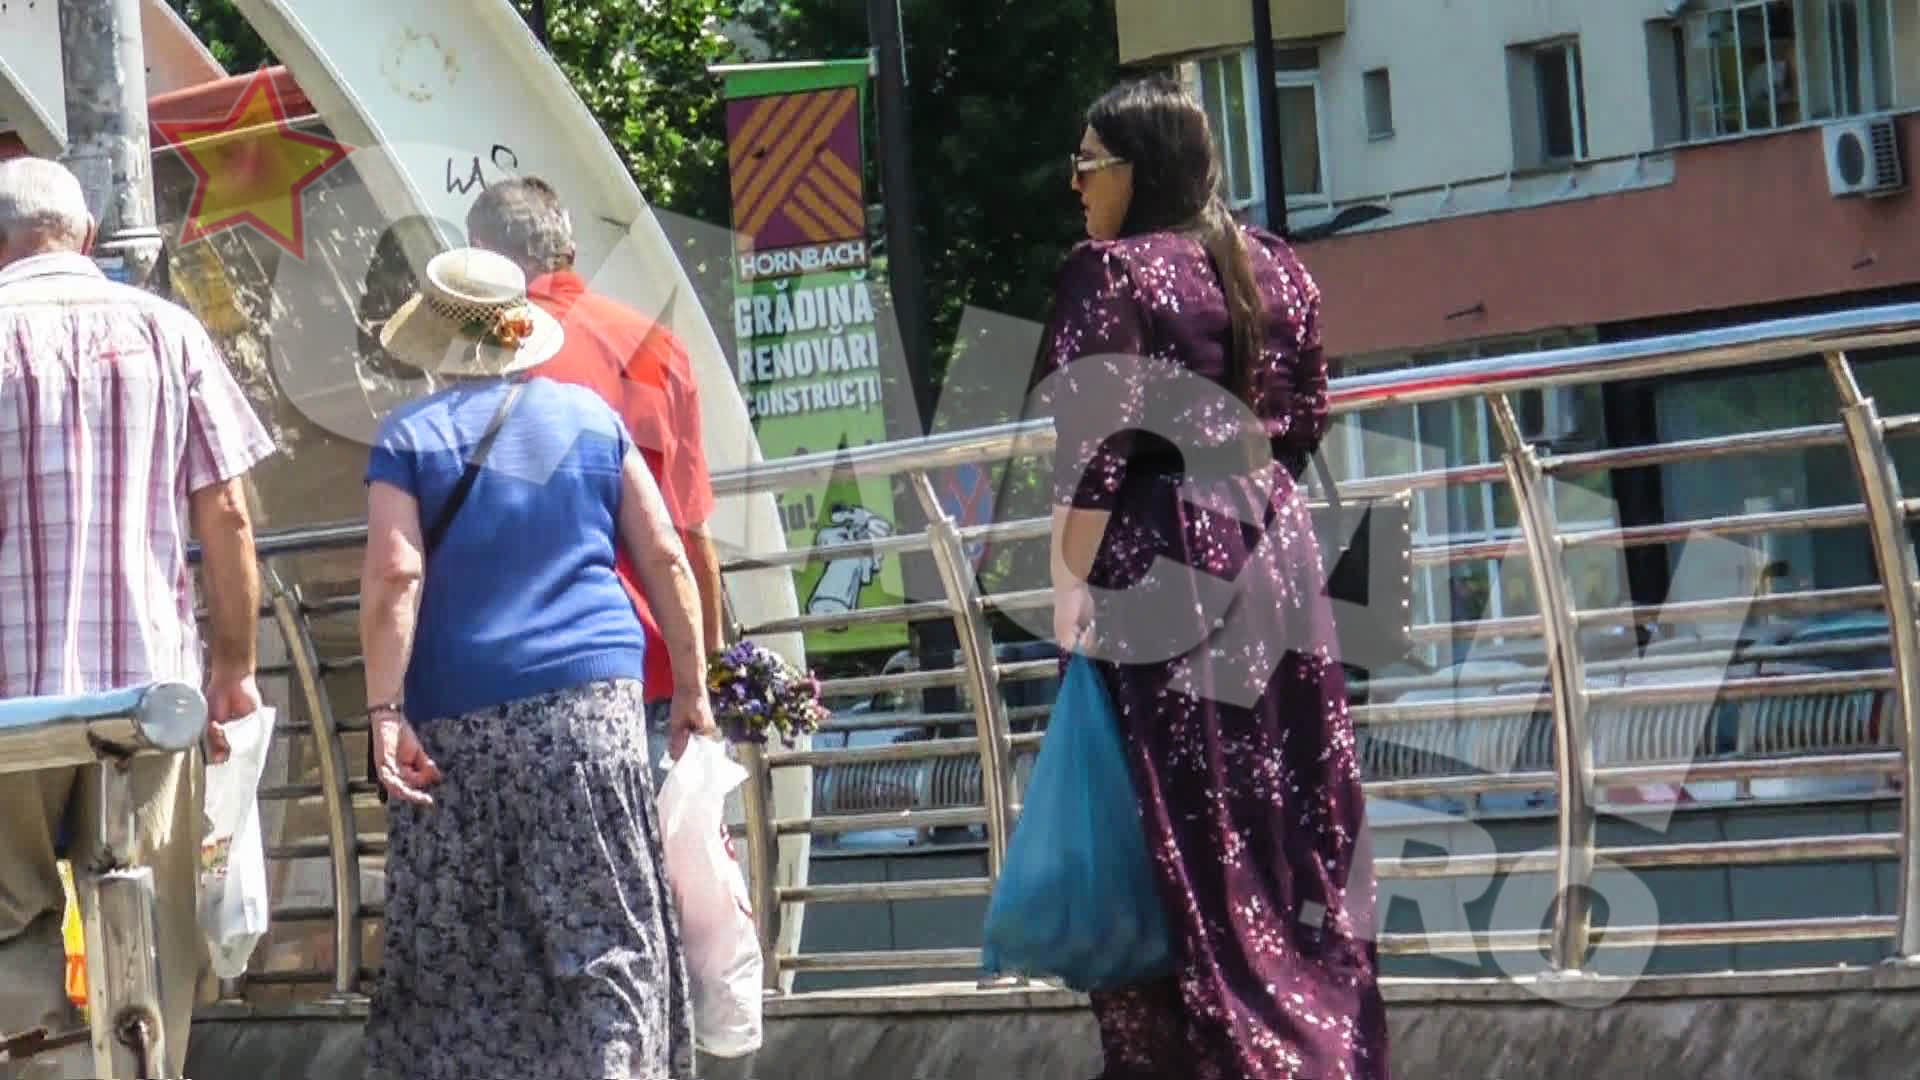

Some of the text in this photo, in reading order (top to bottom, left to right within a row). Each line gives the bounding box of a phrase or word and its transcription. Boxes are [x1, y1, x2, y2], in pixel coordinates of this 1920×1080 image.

[740, 240, 866, 278] HORNBACH
[735, 269, 875, 338] GRĂDINĂ
[738, 324, 879, 385] RENOVĂRI
